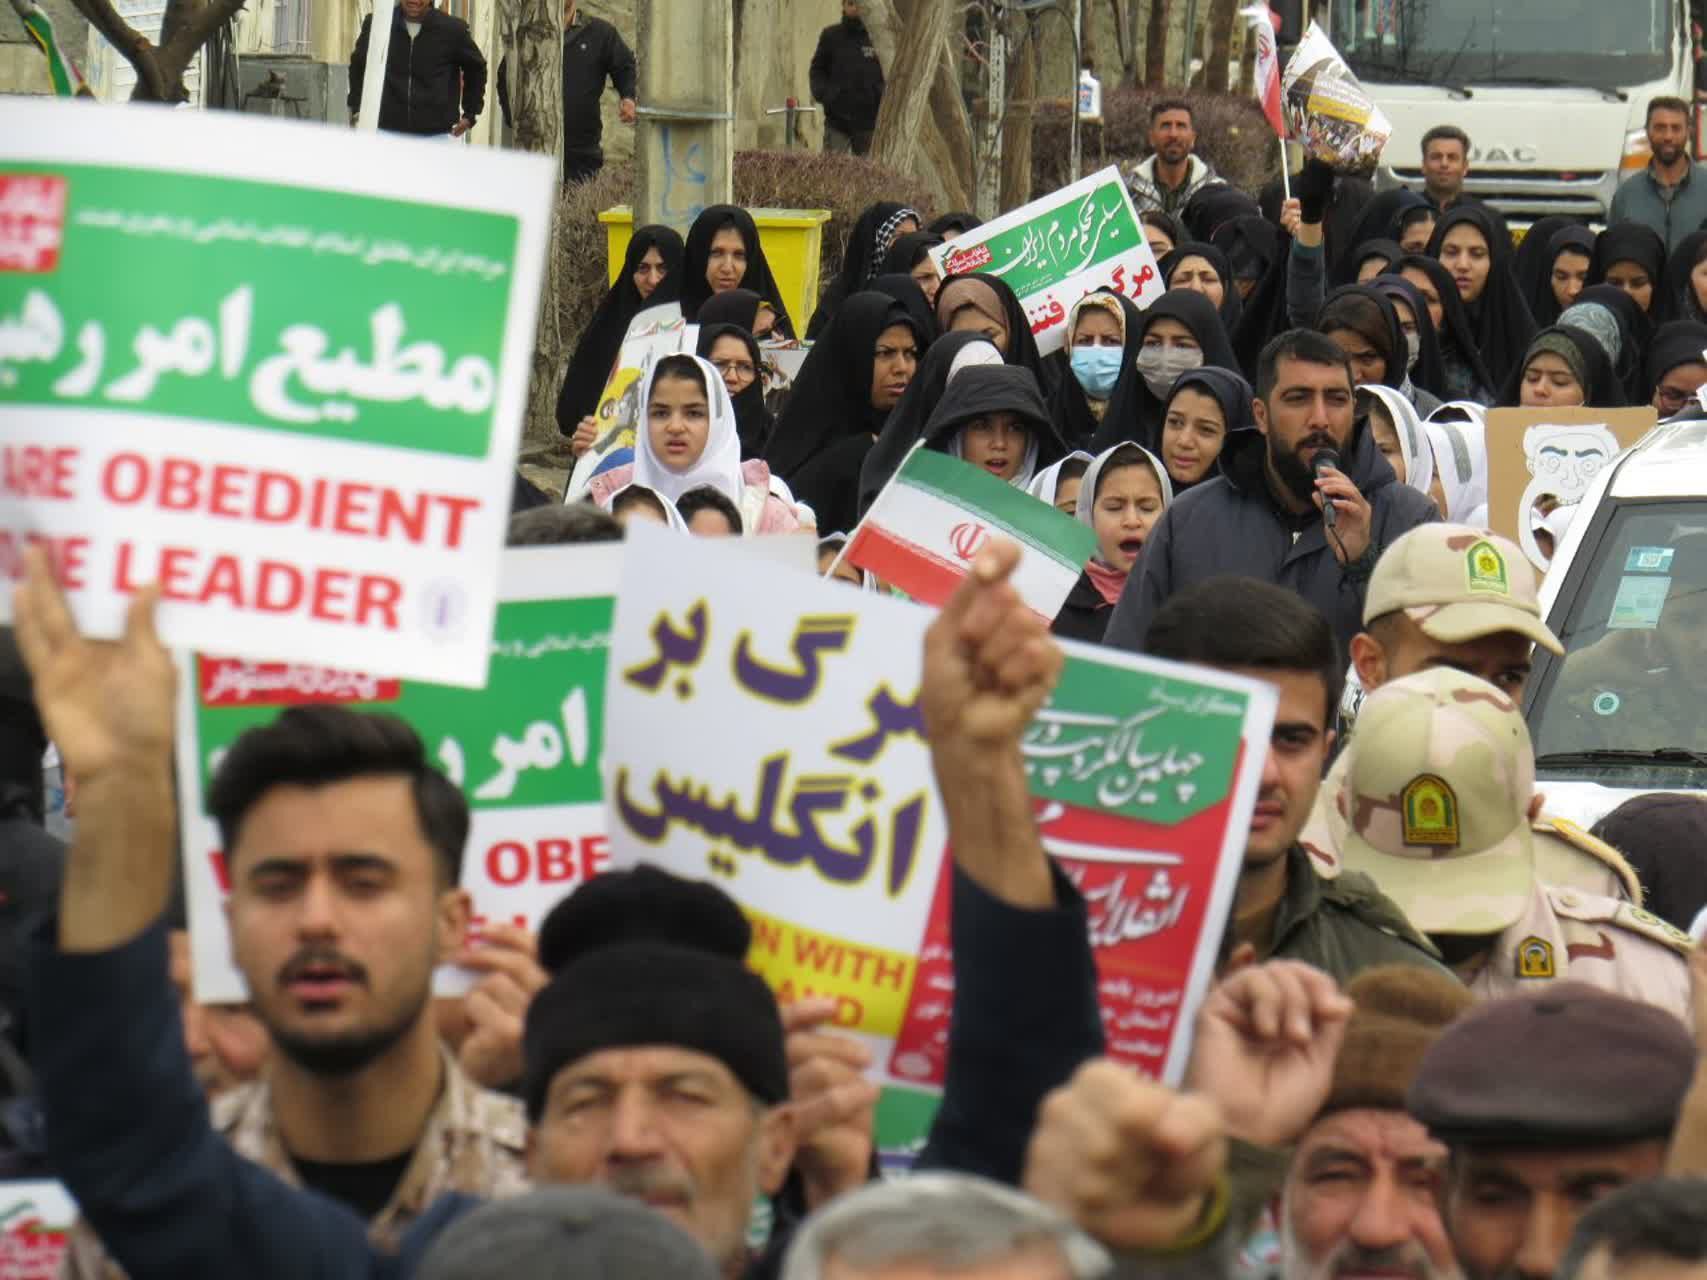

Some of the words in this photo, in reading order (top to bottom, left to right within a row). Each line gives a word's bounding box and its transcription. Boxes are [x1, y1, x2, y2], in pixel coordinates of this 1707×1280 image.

[986, 226, 1047, 277] ایران
[1047, 220, 1078, 267] مردم
[103, 284, 254, 401] امر
[251, 302, 498, 425] مطیع
[101, 450, 482, 550] OBEDIENT
[113, 538, 405, 632] LEADER
[622, 595, 710, 700] بر
[473, 686, 590, 800] امر
[615, 752, 930, 898] انگلیس
[793, 931, 907, 993] WITH
